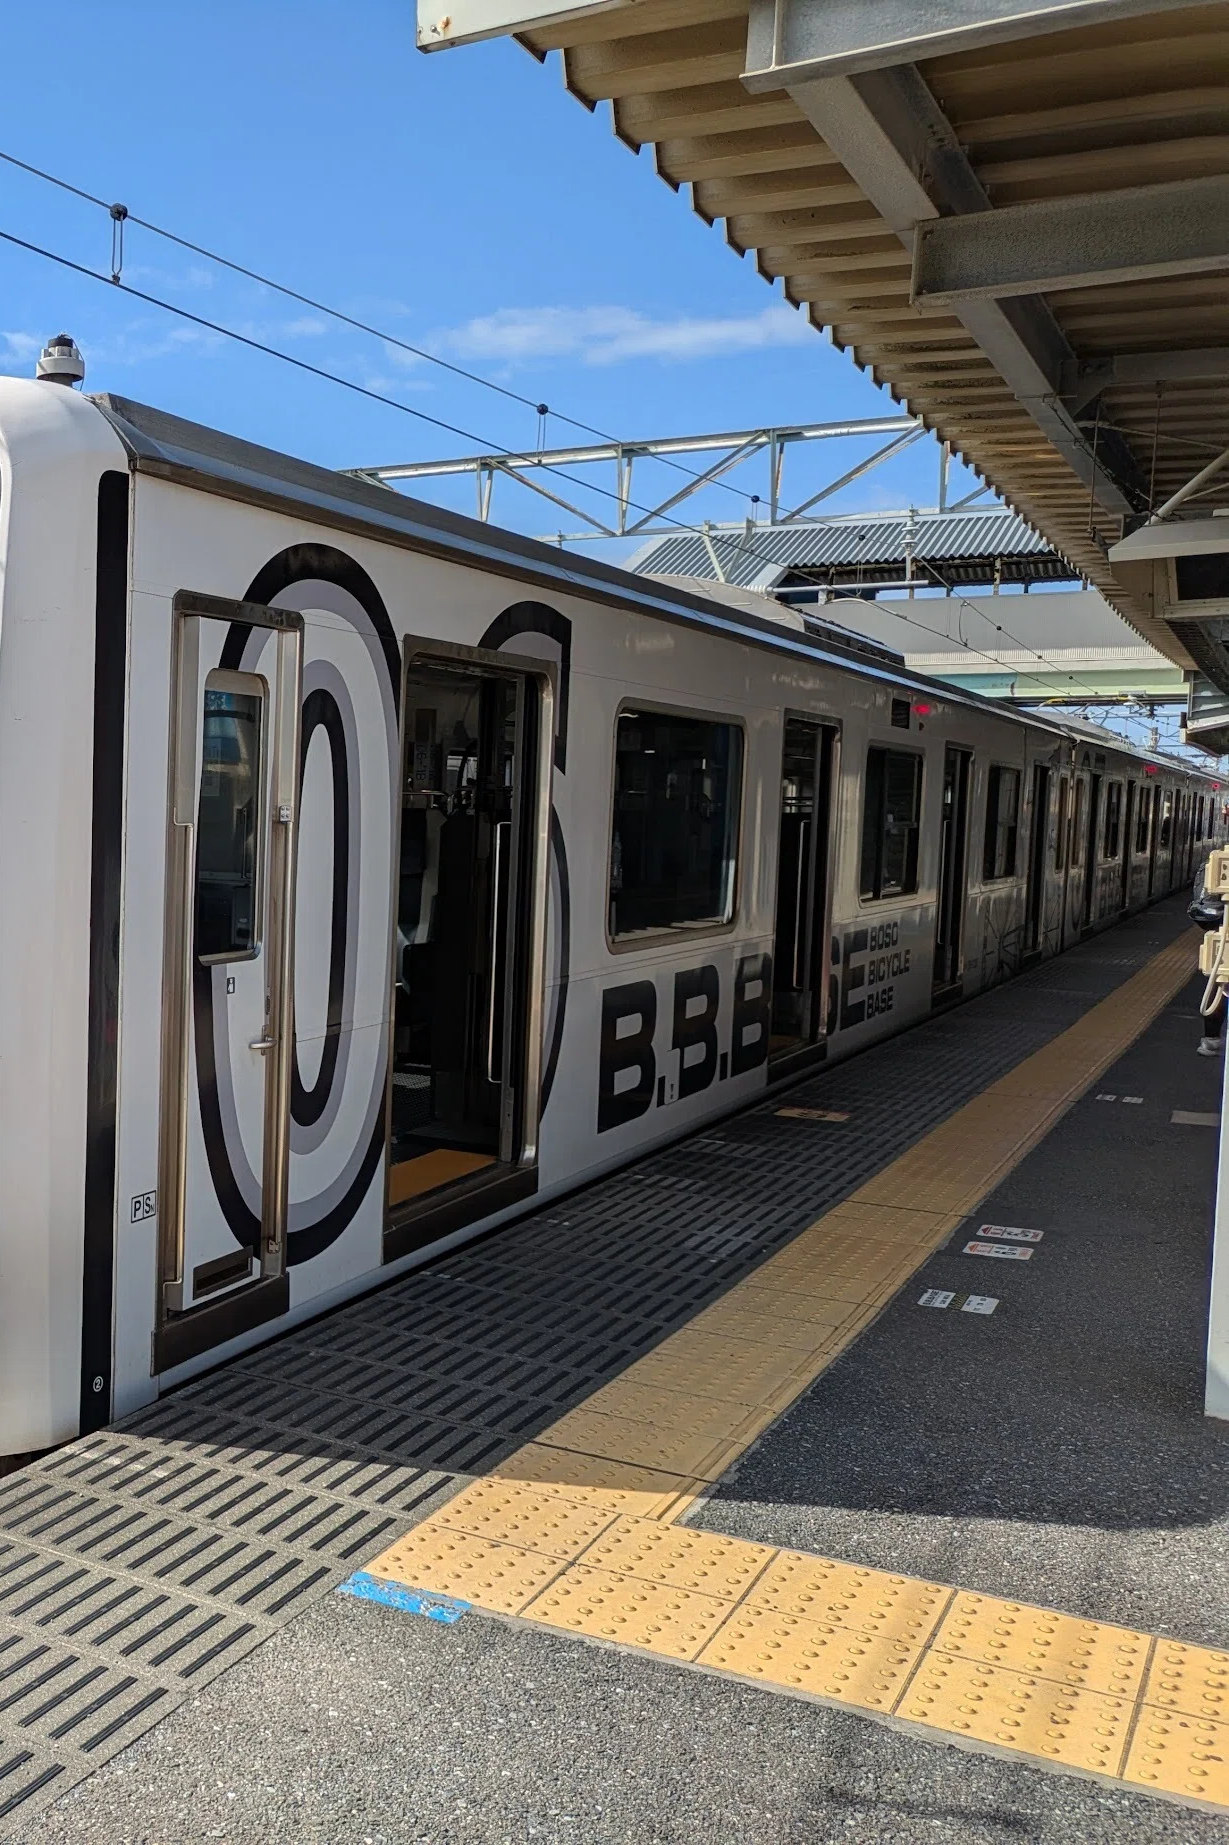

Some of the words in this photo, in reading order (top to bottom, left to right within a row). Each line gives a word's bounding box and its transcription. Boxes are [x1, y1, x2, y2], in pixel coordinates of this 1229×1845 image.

[869, 921, 898, 952] BOSO
[868, 949, 910, 986] BICYCLE
[867, 986, 893, 1020] BASE
